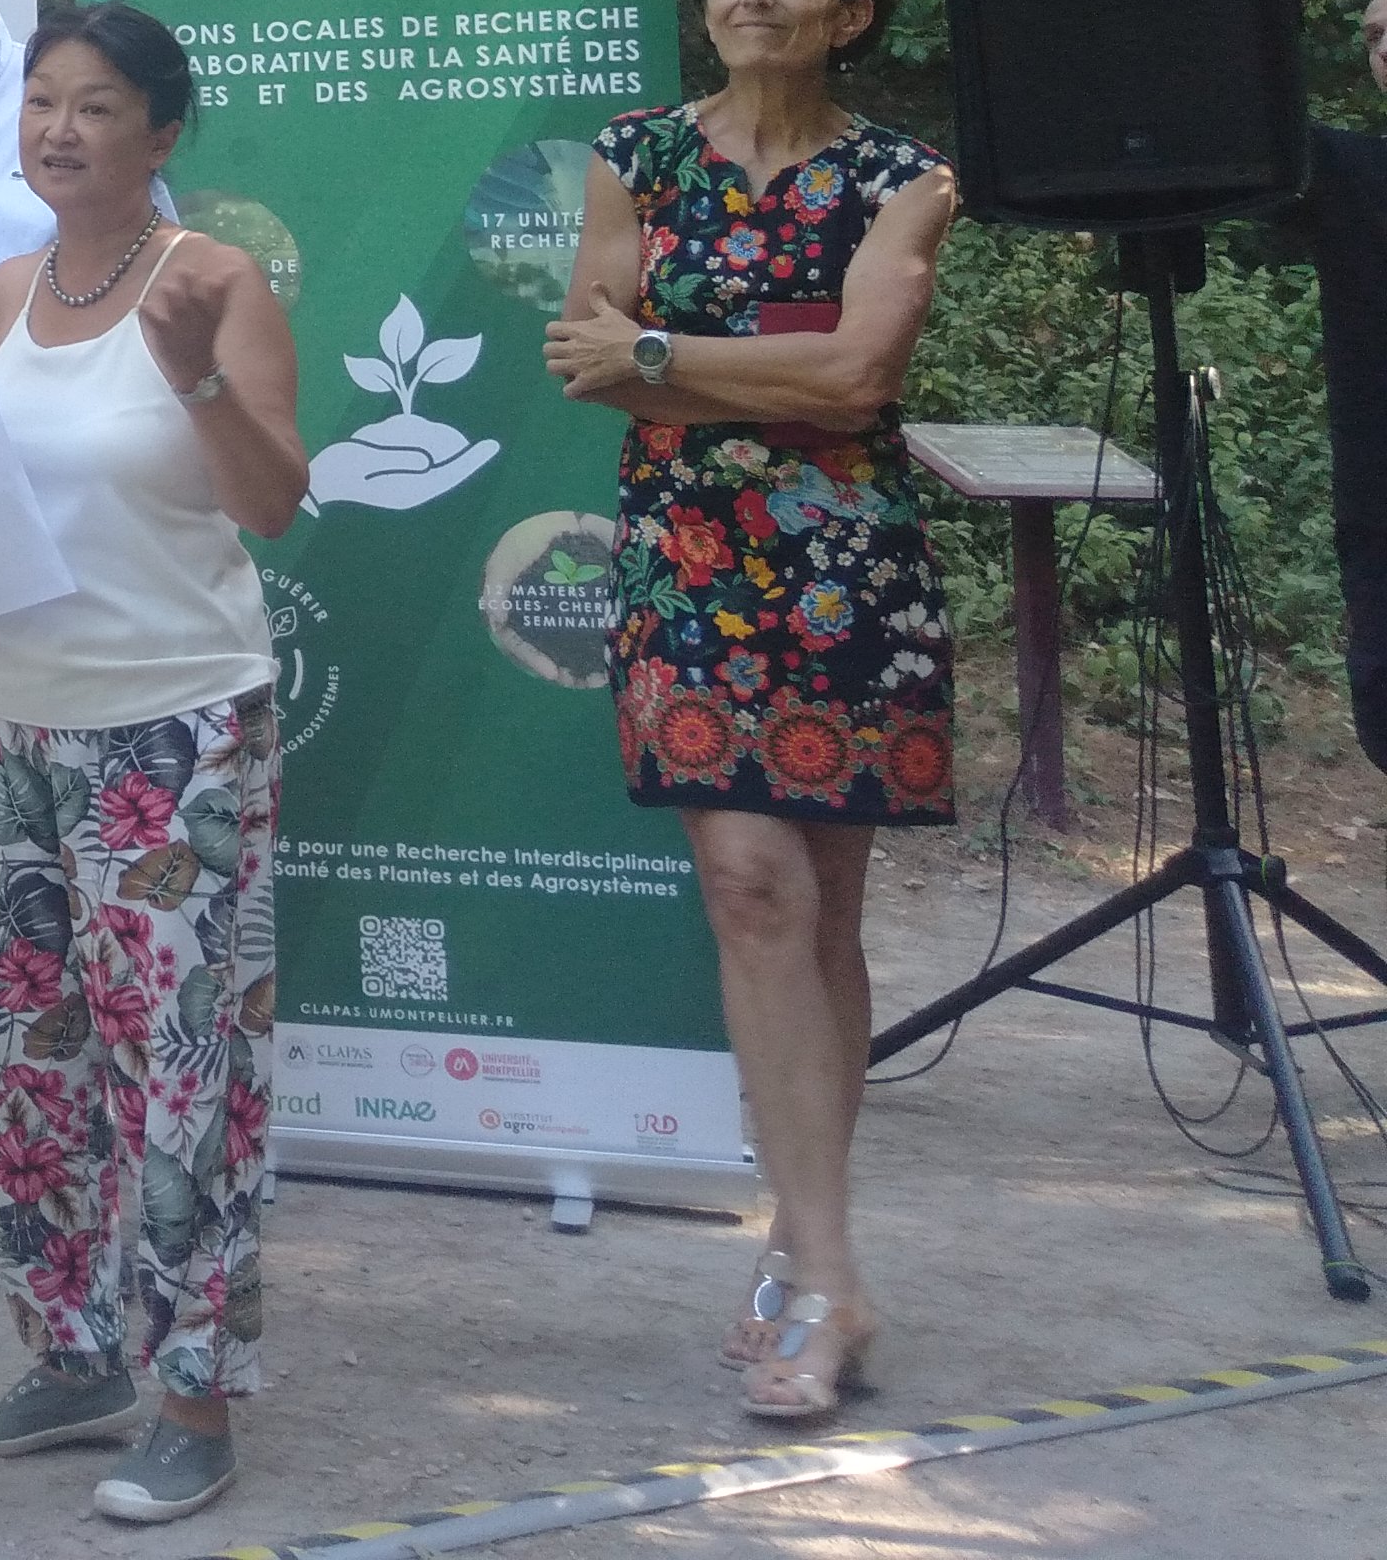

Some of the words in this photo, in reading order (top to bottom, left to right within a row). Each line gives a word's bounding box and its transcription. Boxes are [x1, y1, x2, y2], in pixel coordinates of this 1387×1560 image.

[252, 17, 384, 43] LOCALES
[402, 16, 438, 37] DE
[455, 7, 640, 35] RECHERCHE
[361, 47, 415, 70] SUR
[429, 46, 464, 69] LA
[476, 36, 572, 67] SANTÉ
[584, 39, 640, 62] DES
[259, 84, 286, 105] ET
[315, 81, 368, 103] DES
[398, 68, 642, 101] AGROSYSTÈMES
[481, 213, 505, 228] 17
[271, 259, 297, 273] DE
[261, 568, 328, 623] GUÉRIR
[511, 585, 586, 598] MASTERS
[278, 664, 340, 758] AGROSYSTÈMES
[298, 841, 344, 857] pour
[351, 843, 388, 858] une
[396, 843, 507, 864] Recherche
[514, 848, 692, 873] Interdisciplinaire
[273, 860, 330, 878] Santé
[336, 863, 372, 881] des
[379, 866, 452, 885] Plantes
[459, 869, 479, 886] et
[486, 871, 523, 888] des
[530, 873, 678, 896] Agrosystèmes
[317, 1044, 373, 1060] CLAPAS
[503, 1120, 535, 1134] agro
